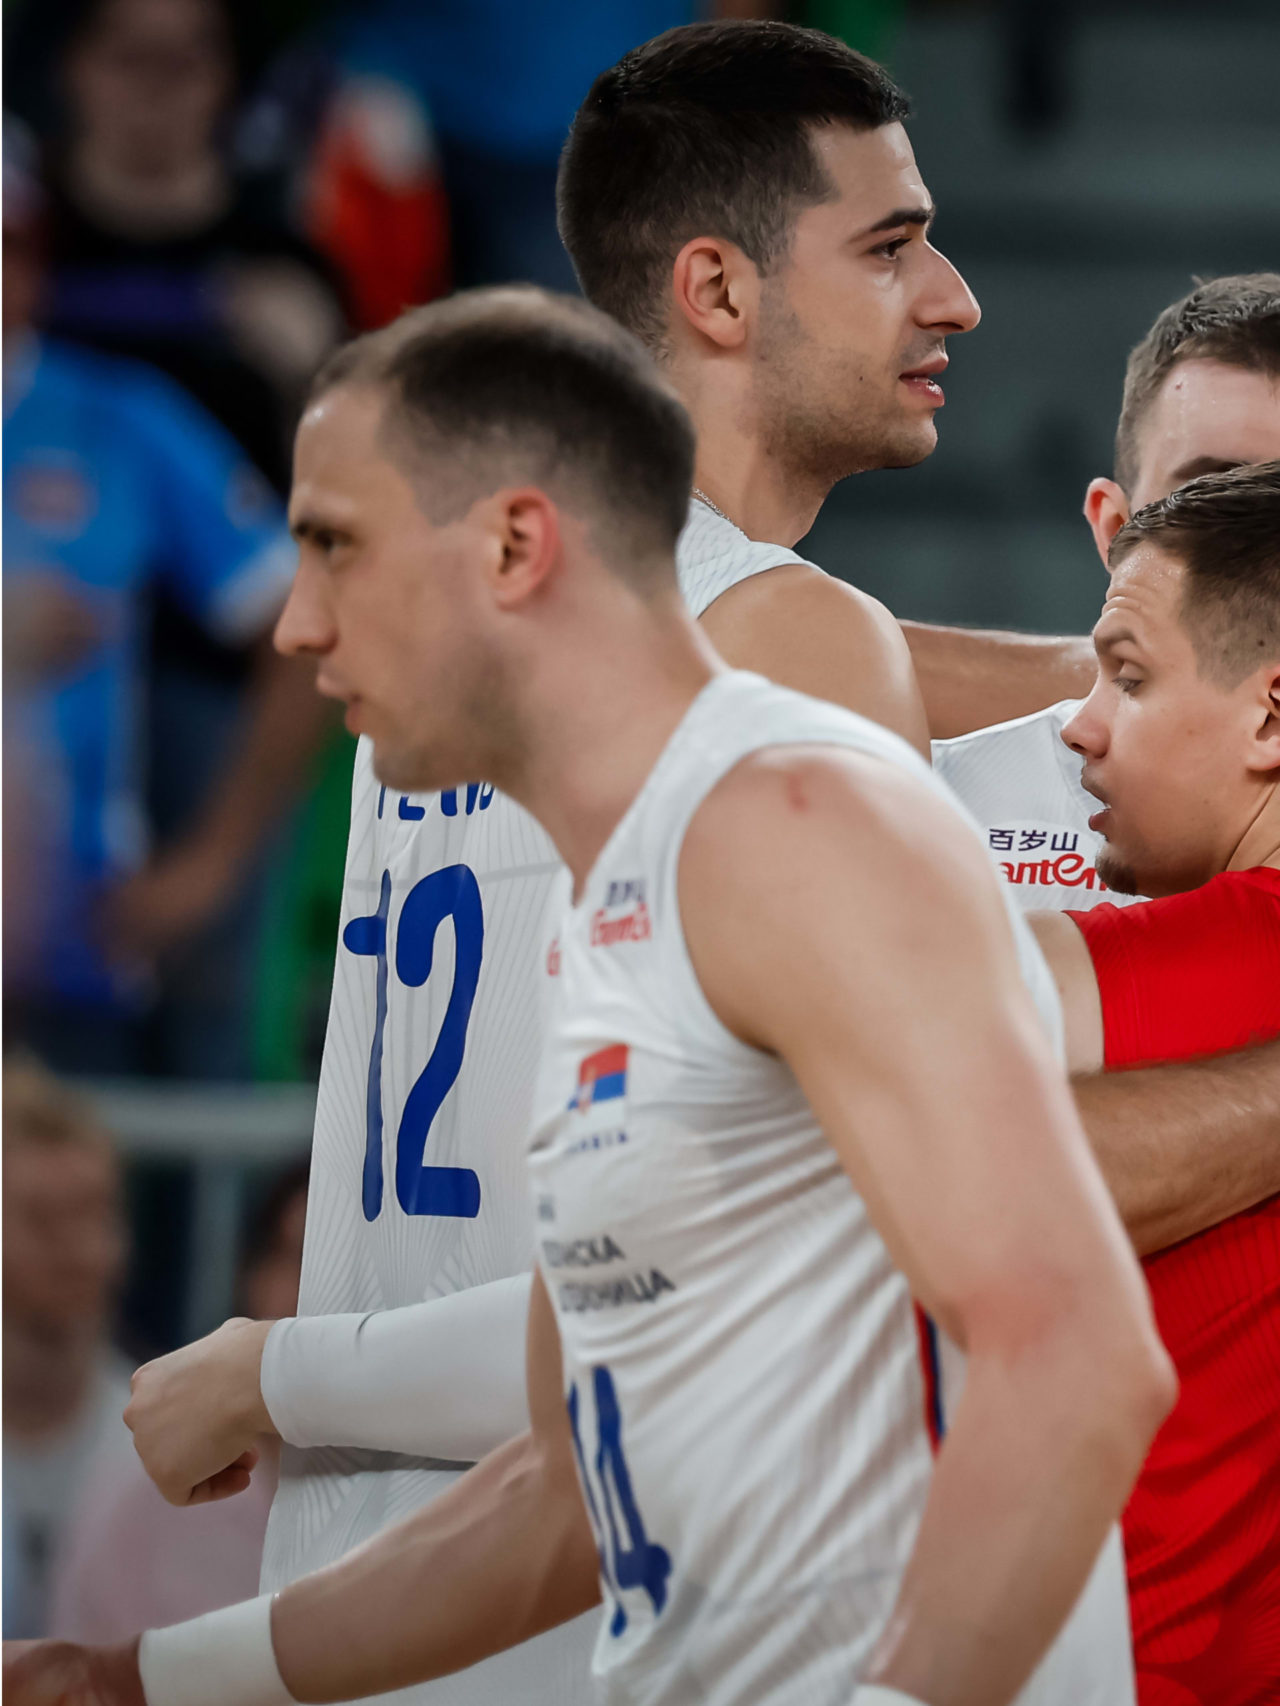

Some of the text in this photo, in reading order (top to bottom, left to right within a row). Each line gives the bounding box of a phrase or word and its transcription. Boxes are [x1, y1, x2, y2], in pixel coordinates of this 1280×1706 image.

[989, 828, 1079, 852] 百岁山
[343, 863, 484, 1222] 12
[567, 1364, 673, 1638] 14
